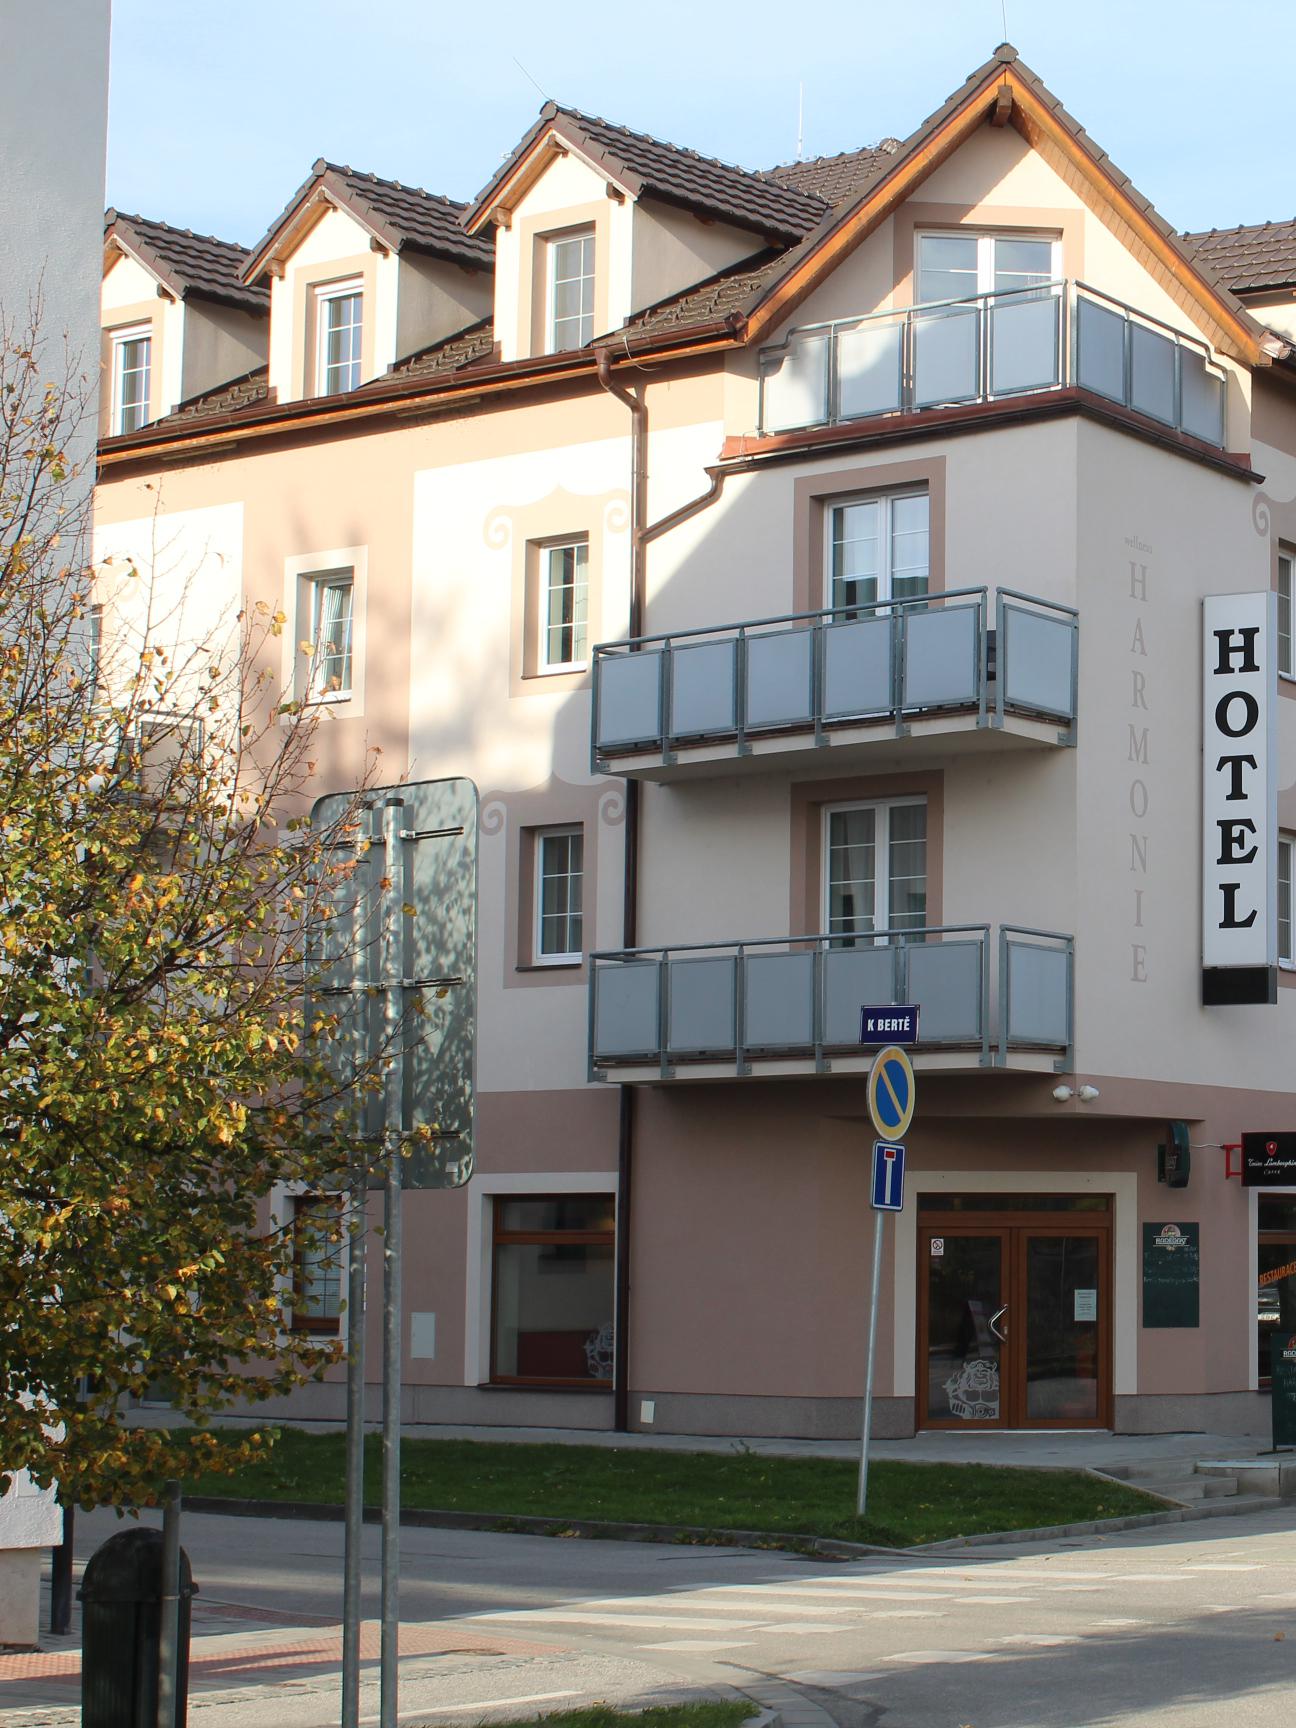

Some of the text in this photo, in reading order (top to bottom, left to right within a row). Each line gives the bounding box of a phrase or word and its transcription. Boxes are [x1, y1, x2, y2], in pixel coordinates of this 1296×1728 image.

[1127, 561, 1151, 983] HARMONIE
[1213, 626, 1260, 930] HOTEL
[867, 1016, 910, 1031] K BERTĚ
